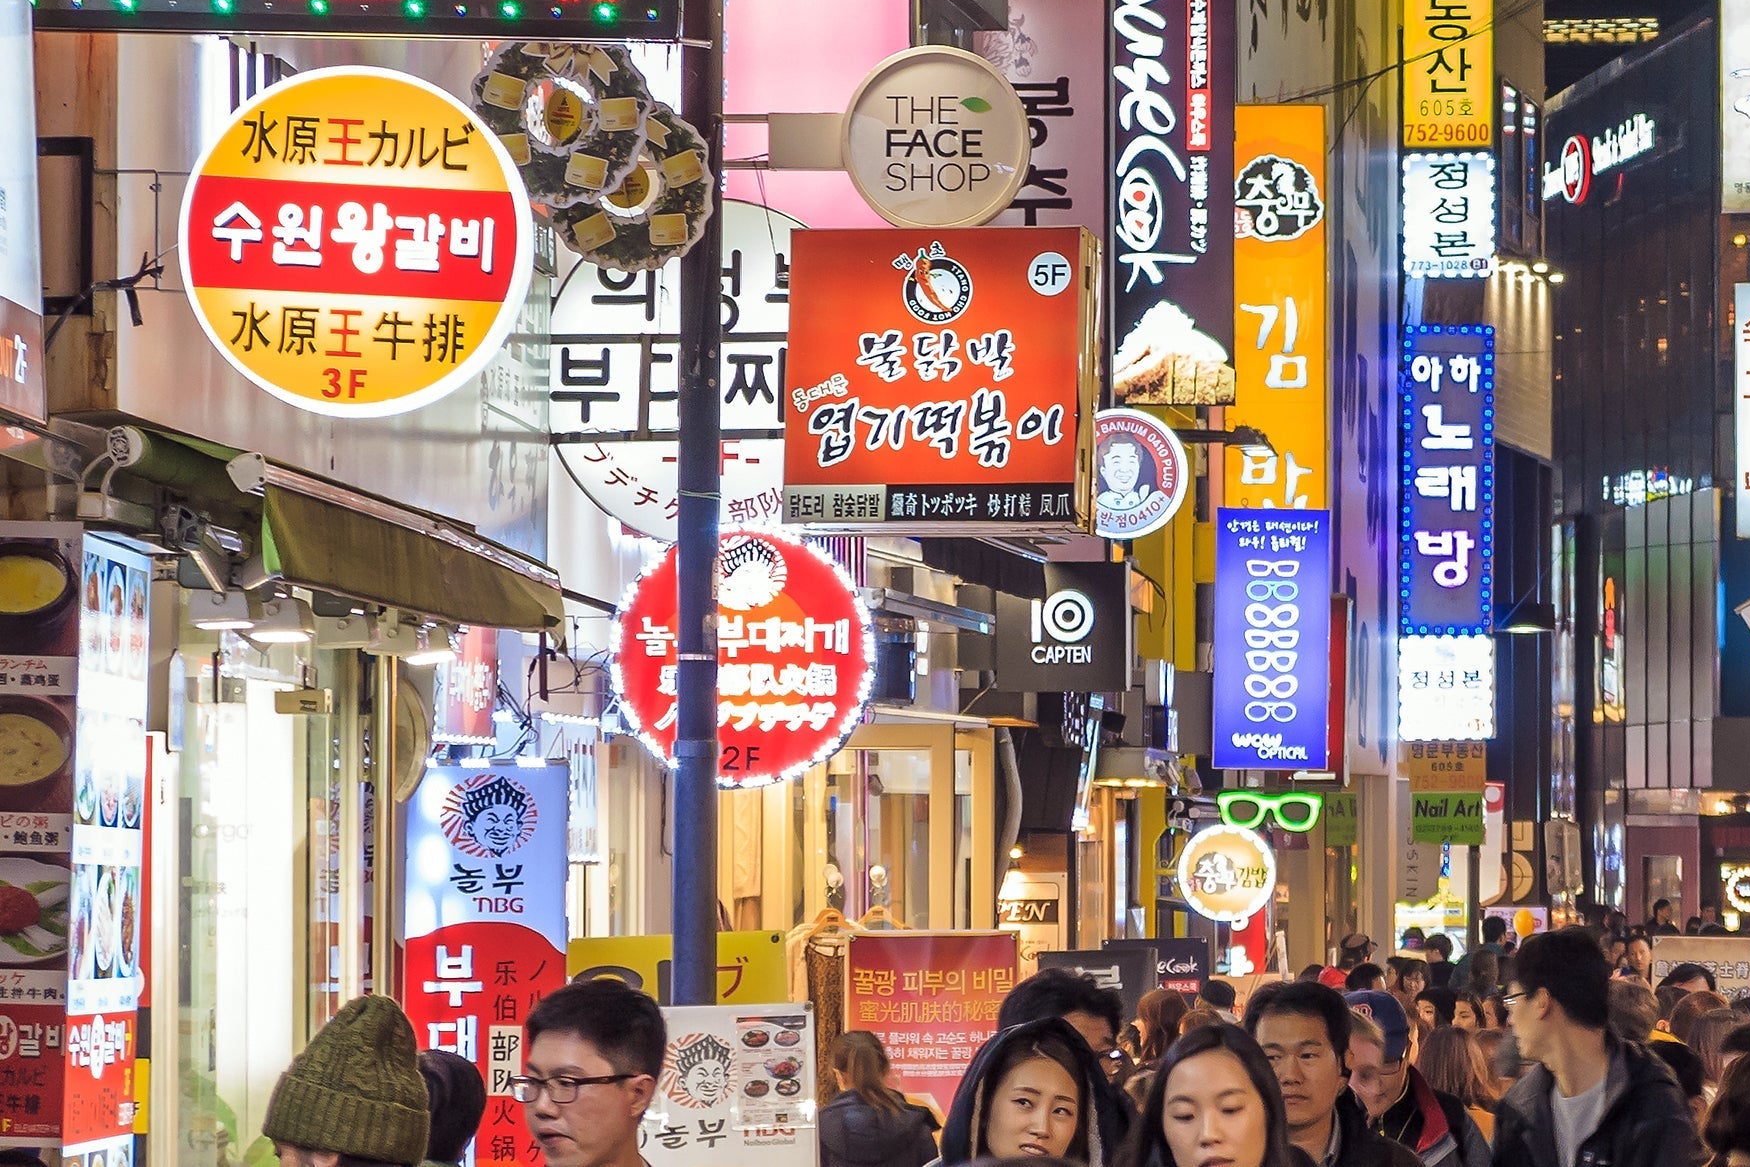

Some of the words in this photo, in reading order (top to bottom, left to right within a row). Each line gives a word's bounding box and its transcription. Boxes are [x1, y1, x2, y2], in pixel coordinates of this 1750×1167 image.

[886, 95, 960, 125] THE
[1419, 99, 1474, 117] 605호
[241, 117, 475, 173] 水原王カルビ
[885, 129, 983, 158] FACE
[1404, 123, 1489, 143] 752-9600
[885, 162, 991, 192] SHOP
[1428, 160, 1476, 258] 정성본
[212, 201, 496, 275] 수원왕갈비
[1033, 264, 1068, 288] 5F
[231, 302, 467, 365] 水原王牛排
[856, 329, 1016, 381] 불닭발
[320, 368, 369, 400] 3F
[1410, 353, 1482, 394] 아하
[808, 389, 1065, 468] 엽기떡볶이
[1099, 420, 1149, 438] BANJUM
[1146, 433, 1167, 458] 0410
[1161, 459, 1174, 489] PLUS
[789, 492, 825, 519] 닭도리
[832, 492, 881, 519] 참숯닭발
[1413, 403, 1478, 589] 노래방
[1031, 645, 1092, 664] CAPTEN
[1411, 669, 1483, 690] 정성본
[1231, 732, 1283, 750] WOW
[1256, 745, 1309, 761] OPTICAL
[722, 745, 761, 772] 2F
[1415, 799, 1449, 819] Nail
[1453, 798, 1483, 819] Art
[449, 863, 525, 895] 놀부
[853, 968, 896, 996] 꿀광
[901, 968, 966, 996] 피부의
[973, 966, 1014, 995] 비밀
[655, 1118, 727, 1150] 놀부
